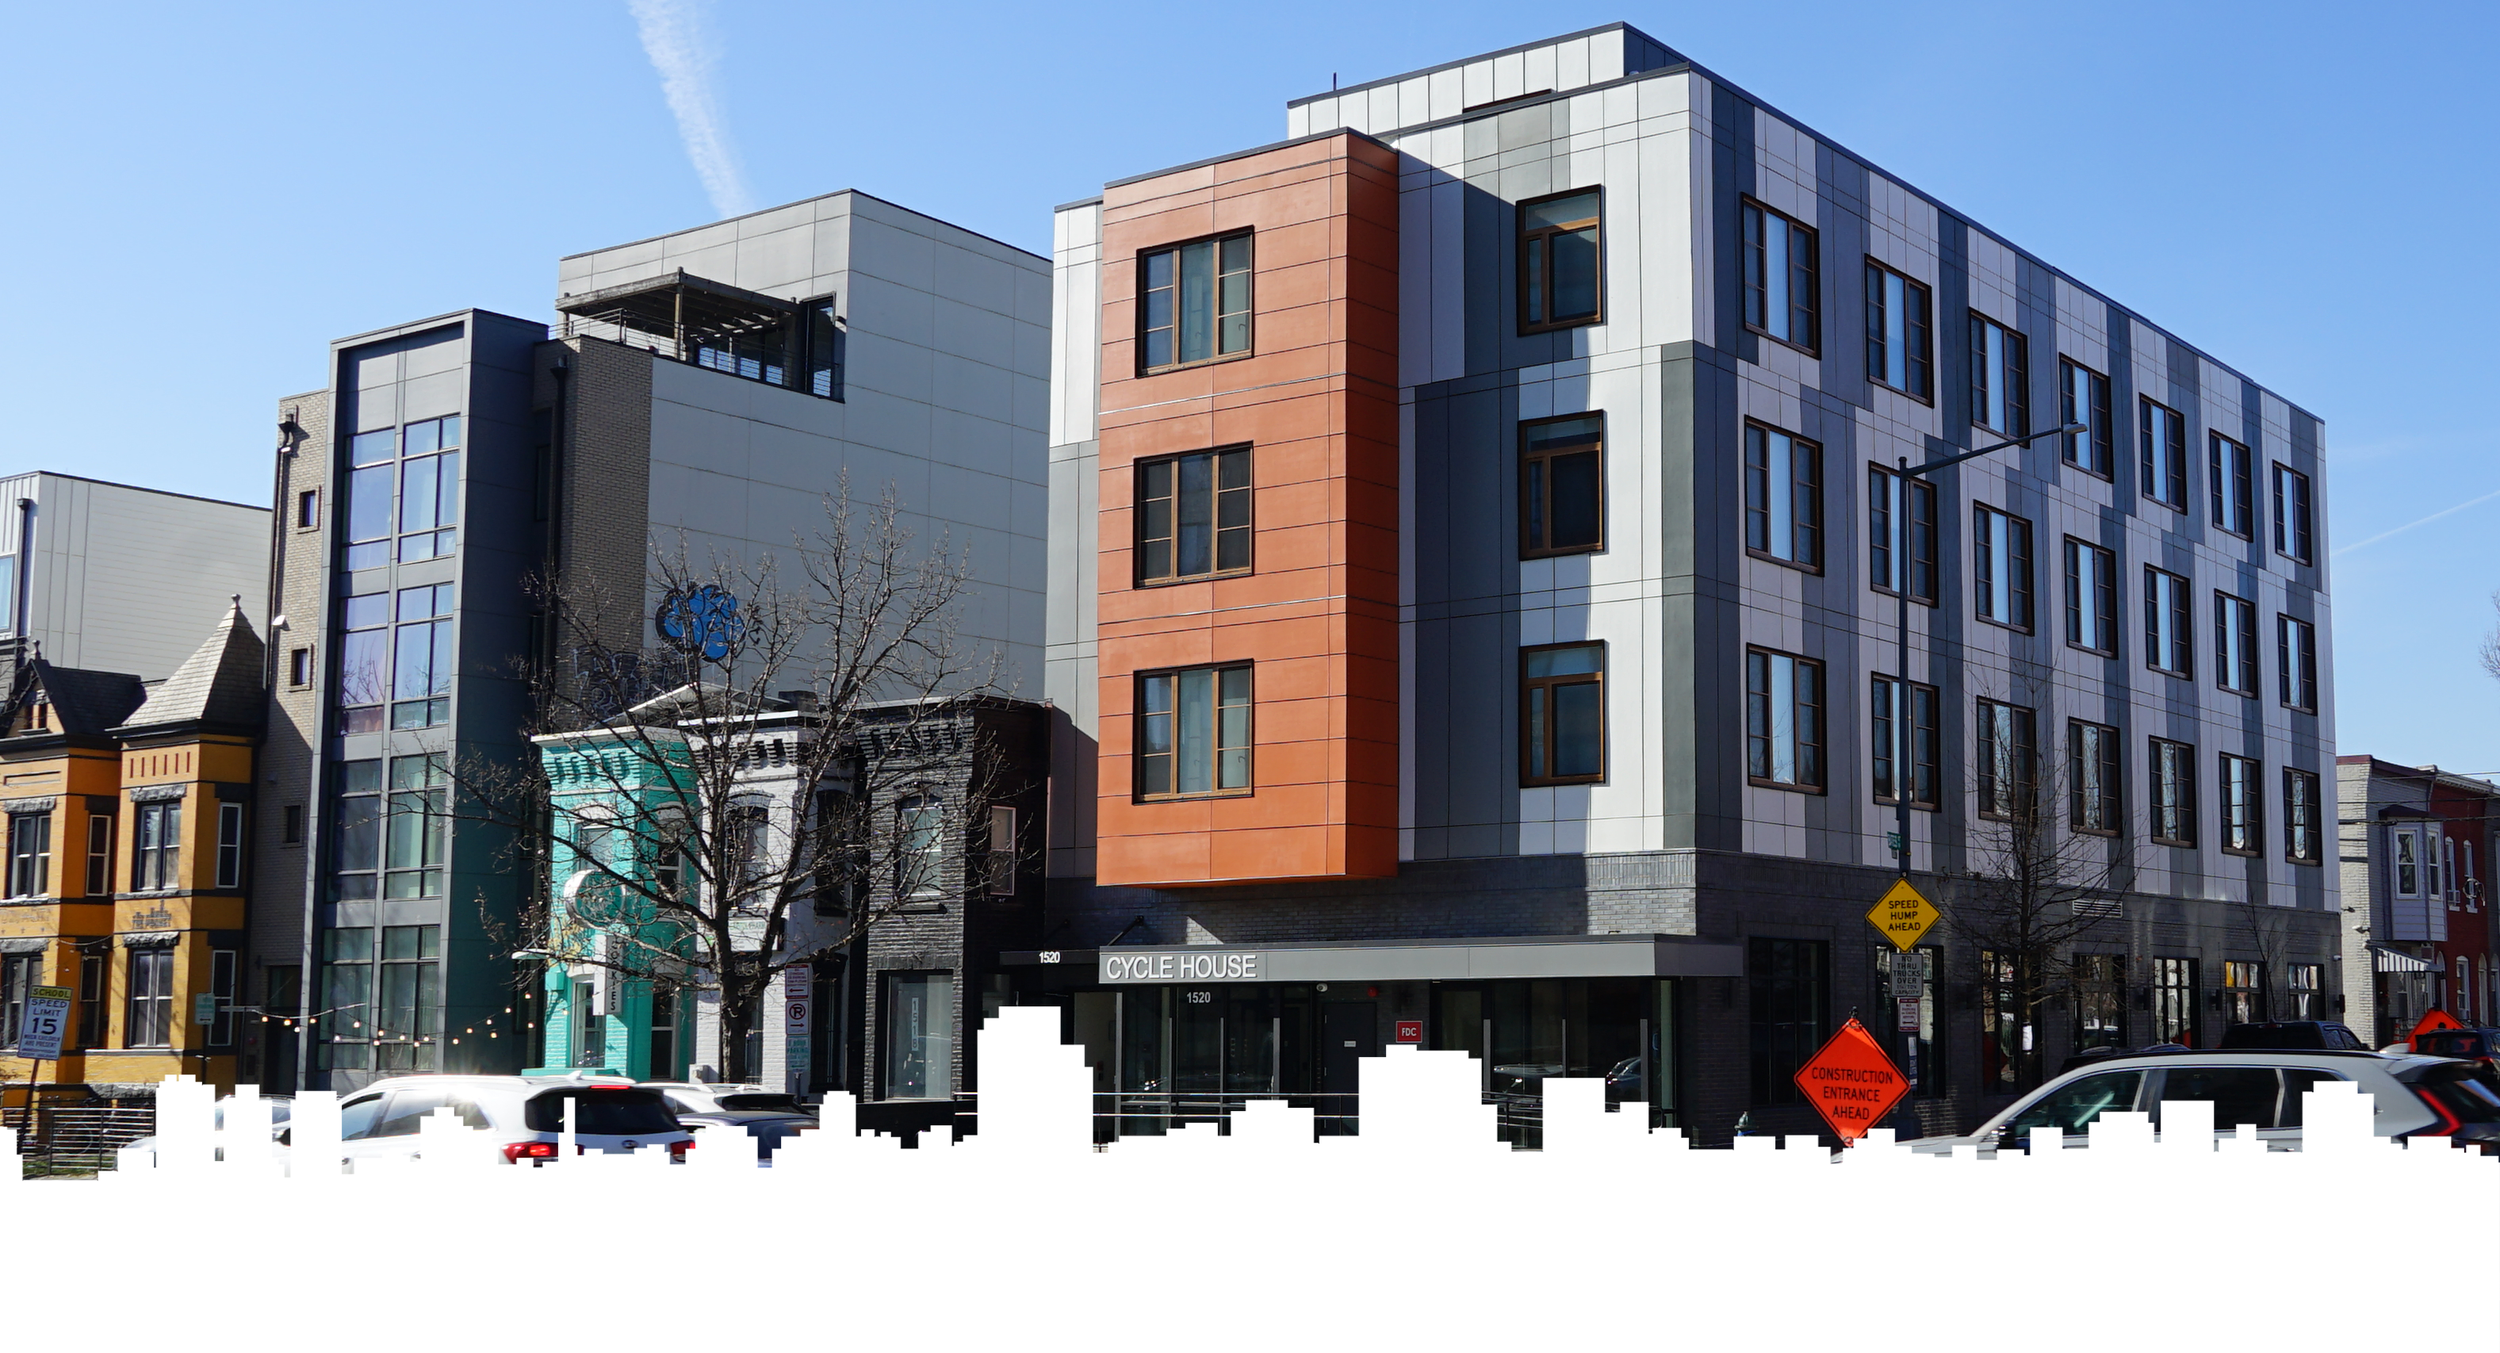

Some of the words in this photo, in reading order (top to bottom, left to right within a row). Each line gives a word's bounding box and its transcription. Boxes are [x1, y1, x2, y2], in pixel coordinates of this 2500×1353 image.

[1888, 900, 1919, 909] SPEED
[1890, 911, 1918, 920] HUMP
[1888, 922, 1921, 931] AHEAD
[1039, 951, 1061, 964] 1520
[1106, 955, 1175, 979] CYCLE
[1180, 954, 1257, 979] HOUSE
[33, 988, 69, 998] SCHOOL
[1186, 992, 1211, 1004] 1520
[31, 998, 67, 1008] SPEED
[33, 1008, 61, 1017] LIMIT
[32, 1017, 57, 1035] 15
[1401, 1027, 1417, 1037] FDC
[1811, 1067, 1893, 1084] CONSTRUCTION
[1823, 1086, 1880, 1102] ENTRANCE
[1831, 1105, 1870, 1120] AHEAD
